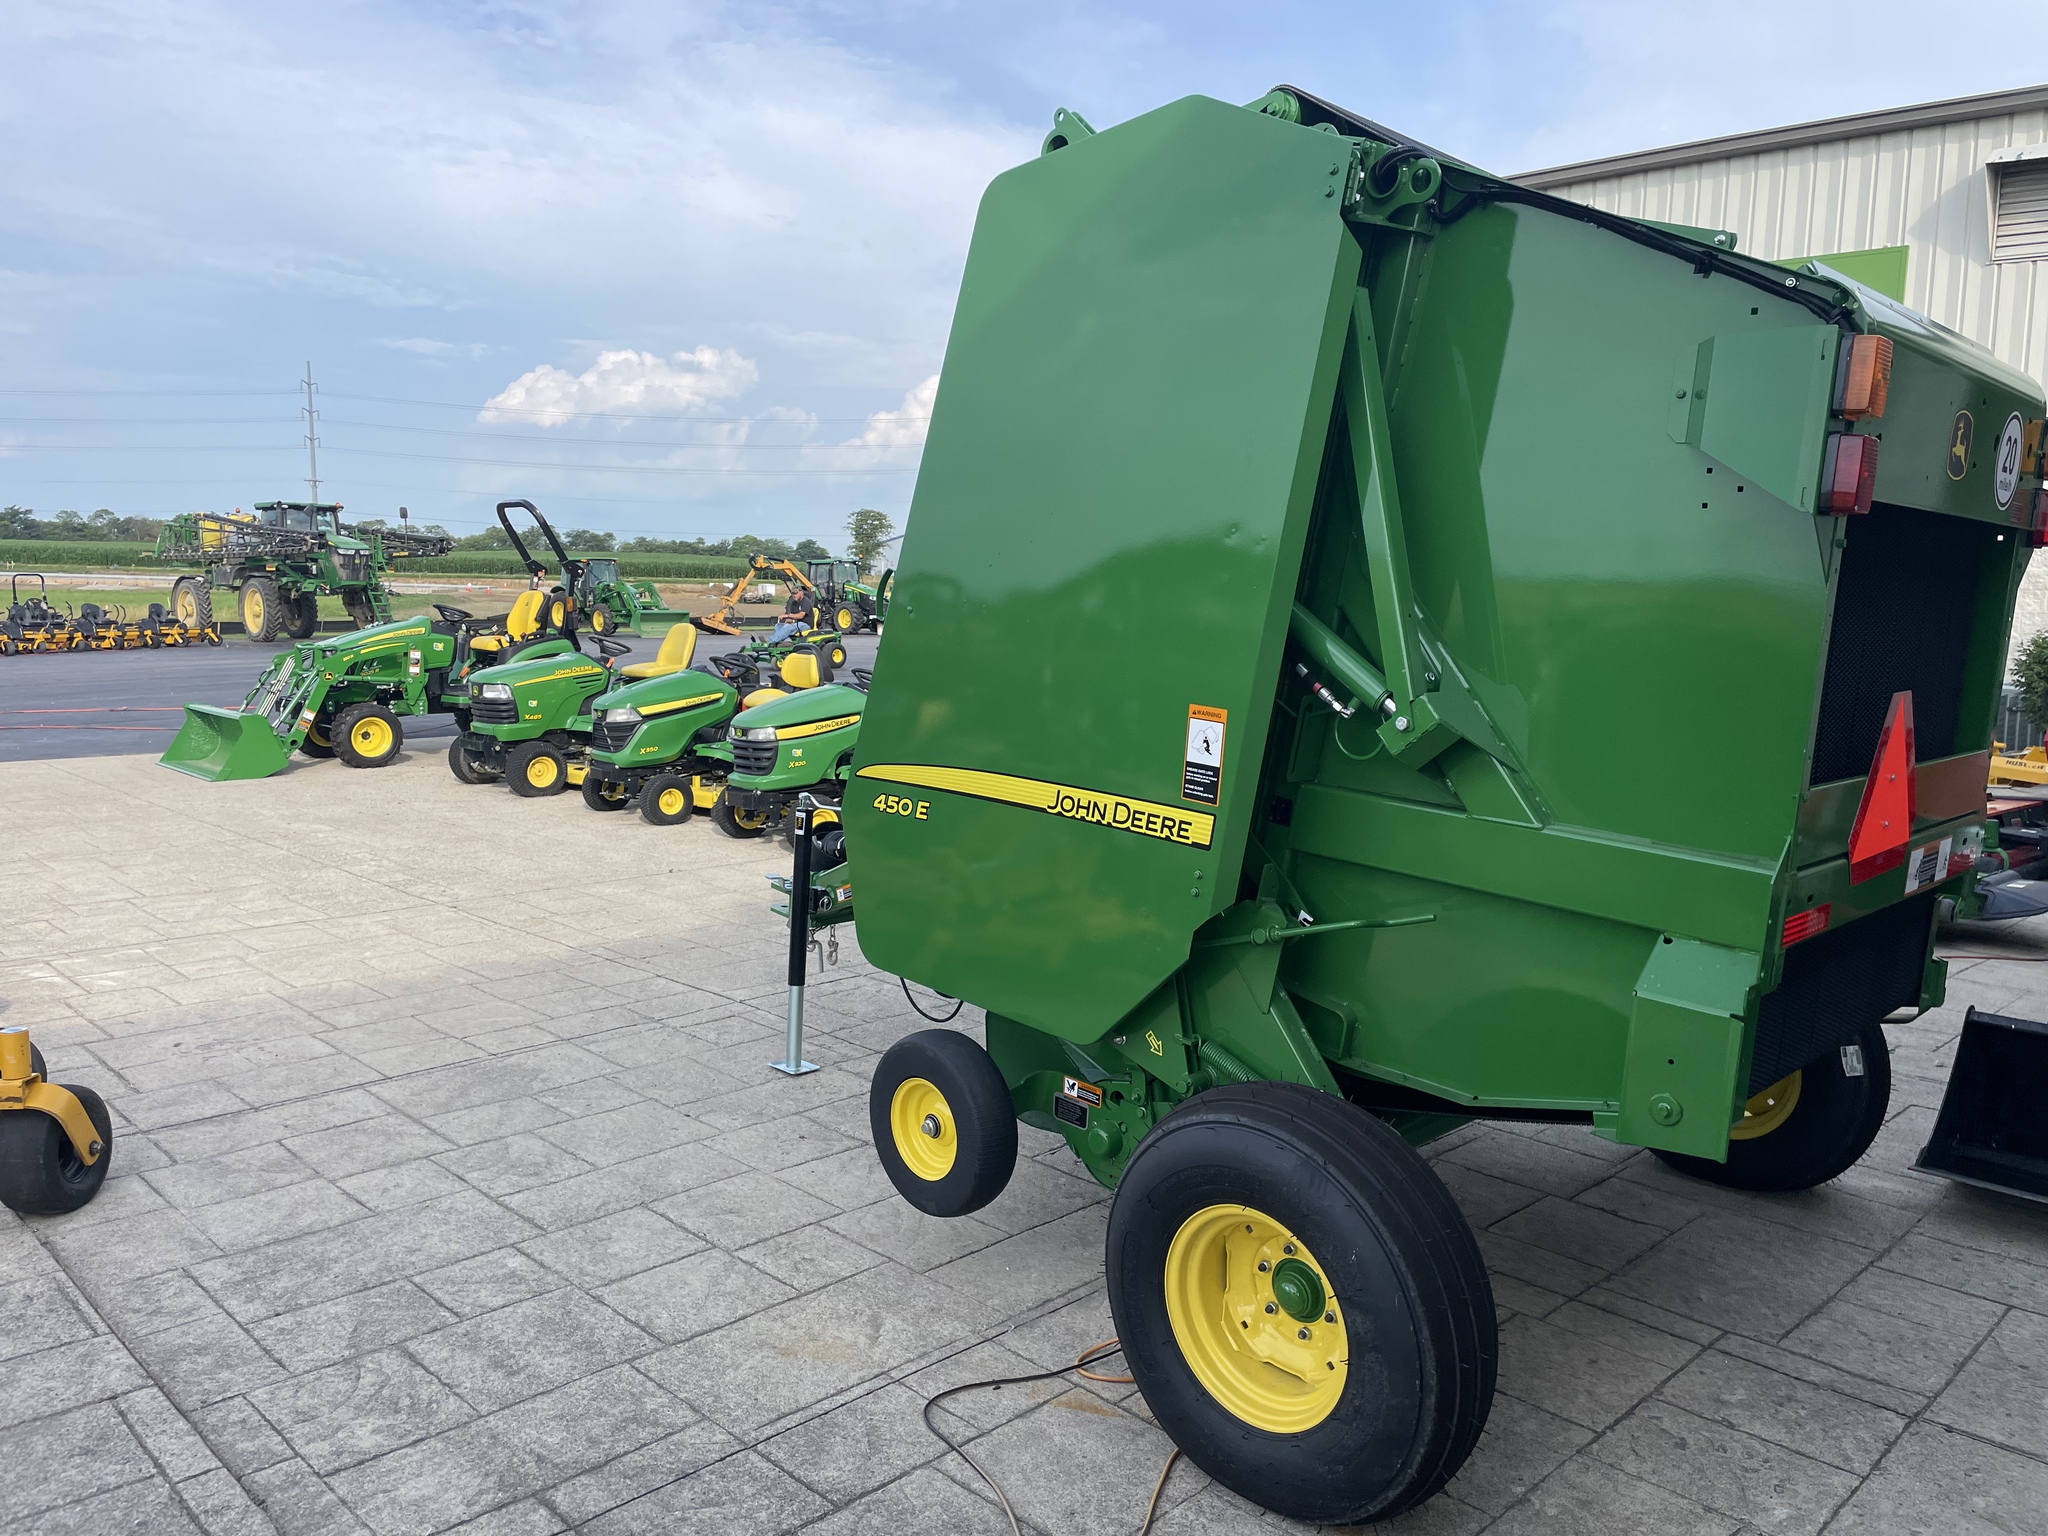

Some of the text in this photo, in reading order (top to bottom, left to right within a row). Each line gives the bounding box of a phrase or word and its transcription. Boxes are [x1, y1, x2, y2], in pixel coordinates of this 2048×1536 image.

[2002, 435, 2017, 475] 20
[553, 665, 593, 677] JOHN DEERE
[1196, 709, 1222, 719] WARNING
[814, 718, 851, 731] JOHN DEERE
[639, 746, 659, 755] X350
[873, 793, 931, 820] 450 E
[1047, 789, 1194, 842] JOHN DEERE
